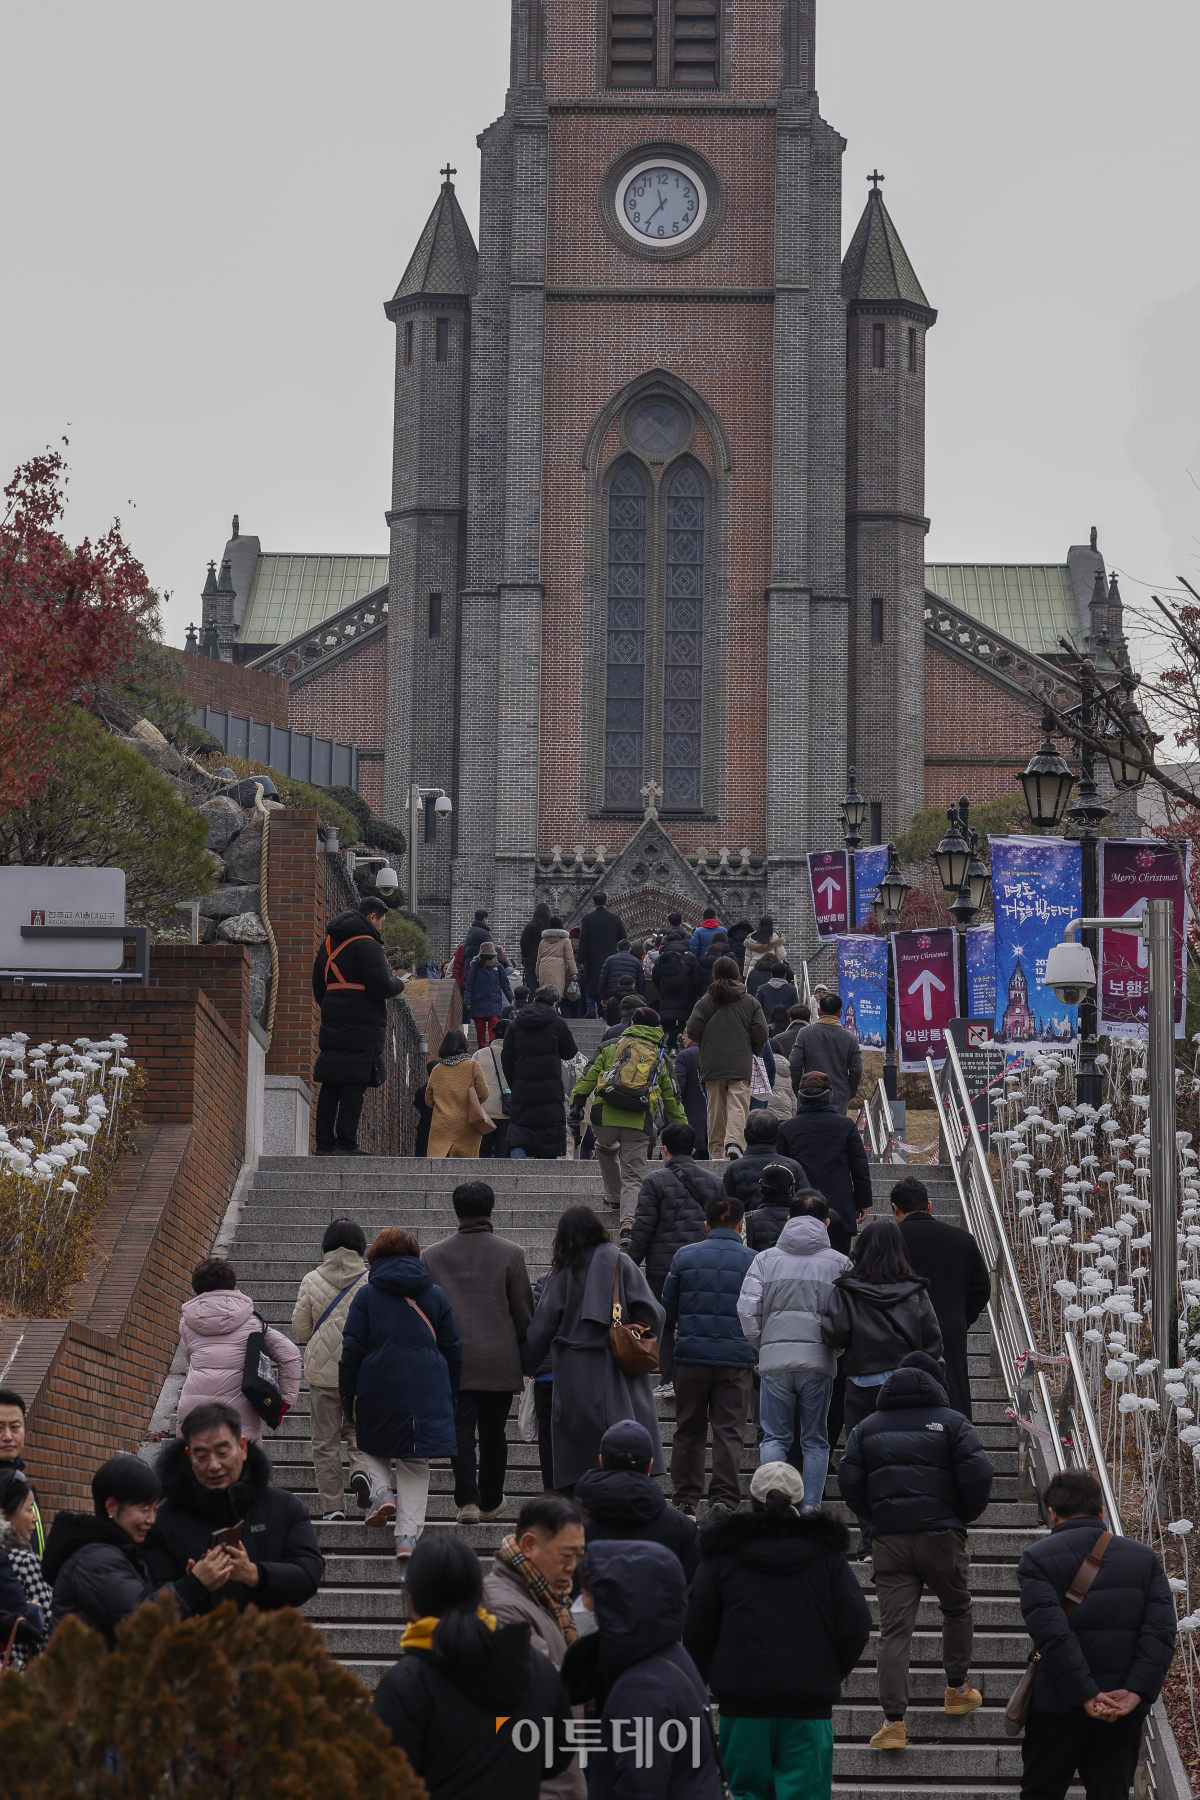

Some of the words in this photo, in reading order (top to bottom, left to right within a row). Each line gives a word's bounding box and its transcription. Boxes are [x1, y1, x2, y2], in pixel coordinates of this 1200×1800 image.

[642, 177, 652, 188] 11
[656, 174, 668, 184] 12
[674, 178, 680, 188] 1
[632, 186, 644, 198] 10
[683, 187, 690, 198] 2
[629, 199, 636, 210] 9
[687, 200, 694, 211] 3
[634, 212, 640, 222] 8
[682, 213, 690, 224] 4
[644, 222, 652, 232] 7
[657, 226, 664, 236] 6
[672, 222, 680, 233] 5
[1111, 873, 1137, 884] Merry
[1138, 873, 1178, 883] Christmas
[74, 912, 115, 920] 서울대교구
[901, 953, 920, 962] Merry
[920, 950, 949, 960] Christmas
[250, 1524, 266, 1532] K2
